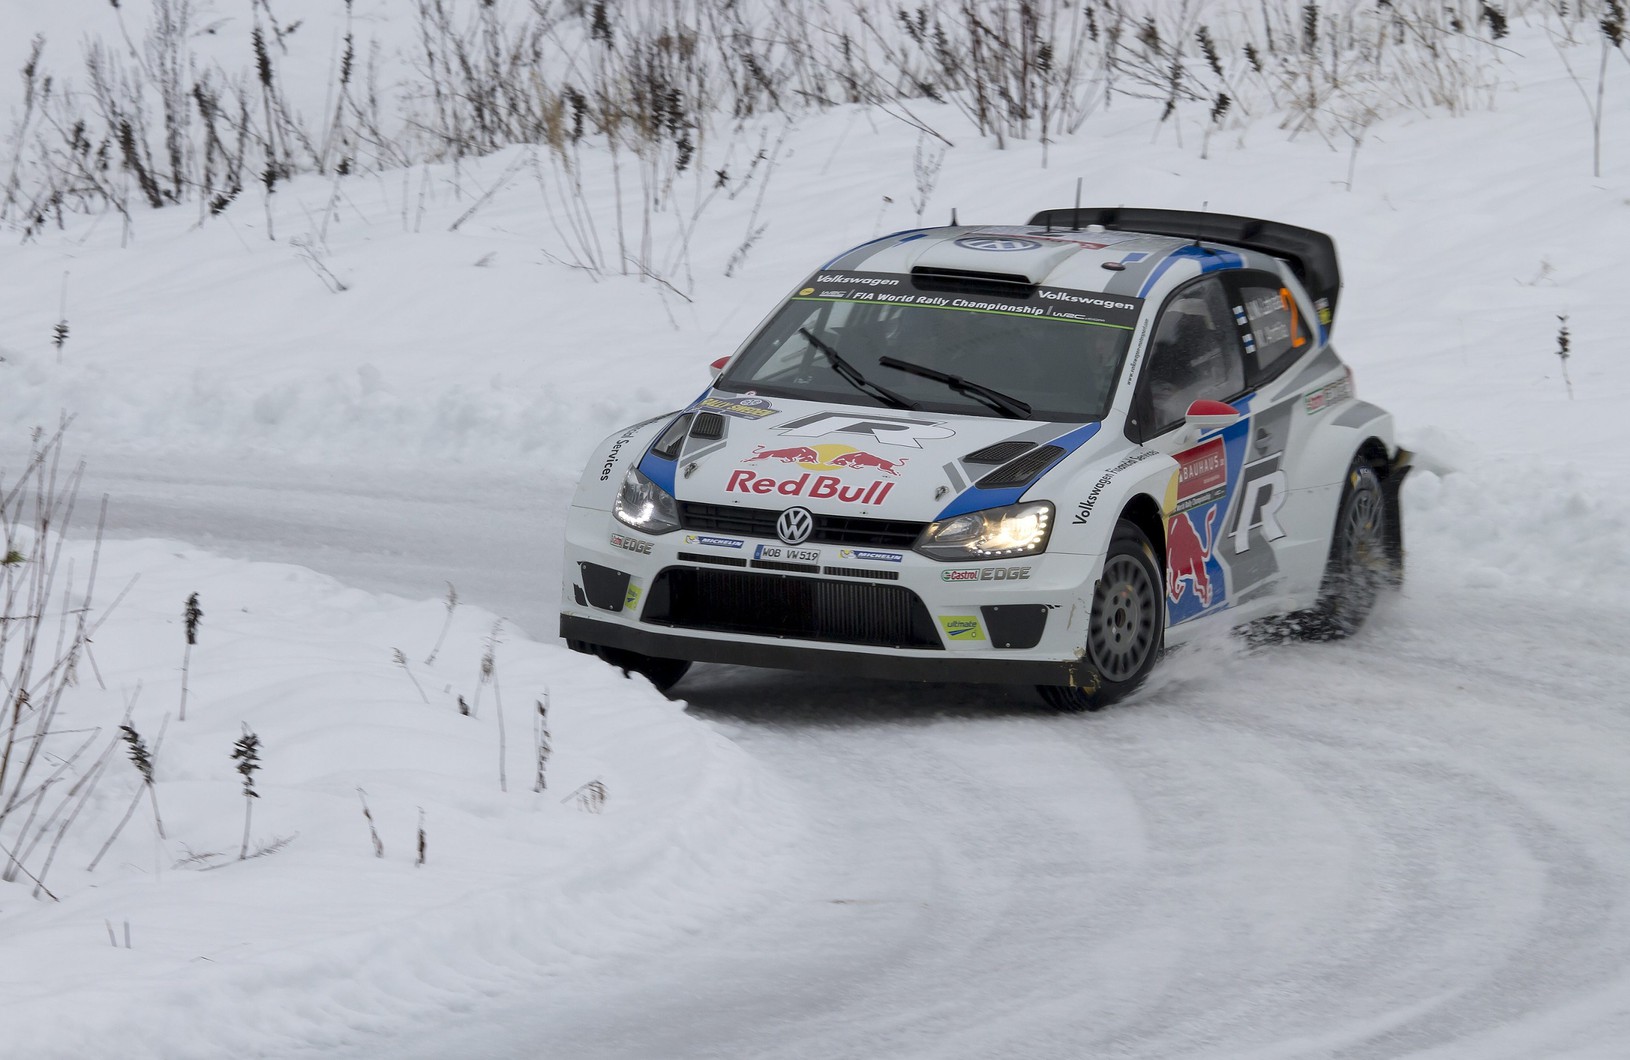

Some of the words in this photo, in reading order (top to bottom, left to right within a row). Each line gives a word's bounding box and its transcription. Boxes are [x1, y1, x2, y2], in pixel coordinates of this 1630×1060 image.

[817, 275, 900, 286] Volkswagen
[853, 292, 875, 300] FIA
[877, 293, 915, 303] World
[916, 296, 950, 306] Rally
[952, 298, 1044, 316] Championship
[1038, 290, 1135, 310] Volkswagen
[1280, 287, 1307, 348] 2
[600, 438, 630, 481] Services
[1183, 455, 1219, 480] BAUHAUS
[725, 469, 811, 498] Red
[808, 474, 896, 505] Bull
[1072, 473, 1115, 525] Volkswagen
[623, 537, 655, 555] EDGE
[701, 537, 743, 547] MICHELIN
[763, 547, 781, 558] WOB
[857, 551, 902, 561] MICHELIN
[950, 570, 978, 580] Castrol
[980, 566, 1032, 581] EDGE
